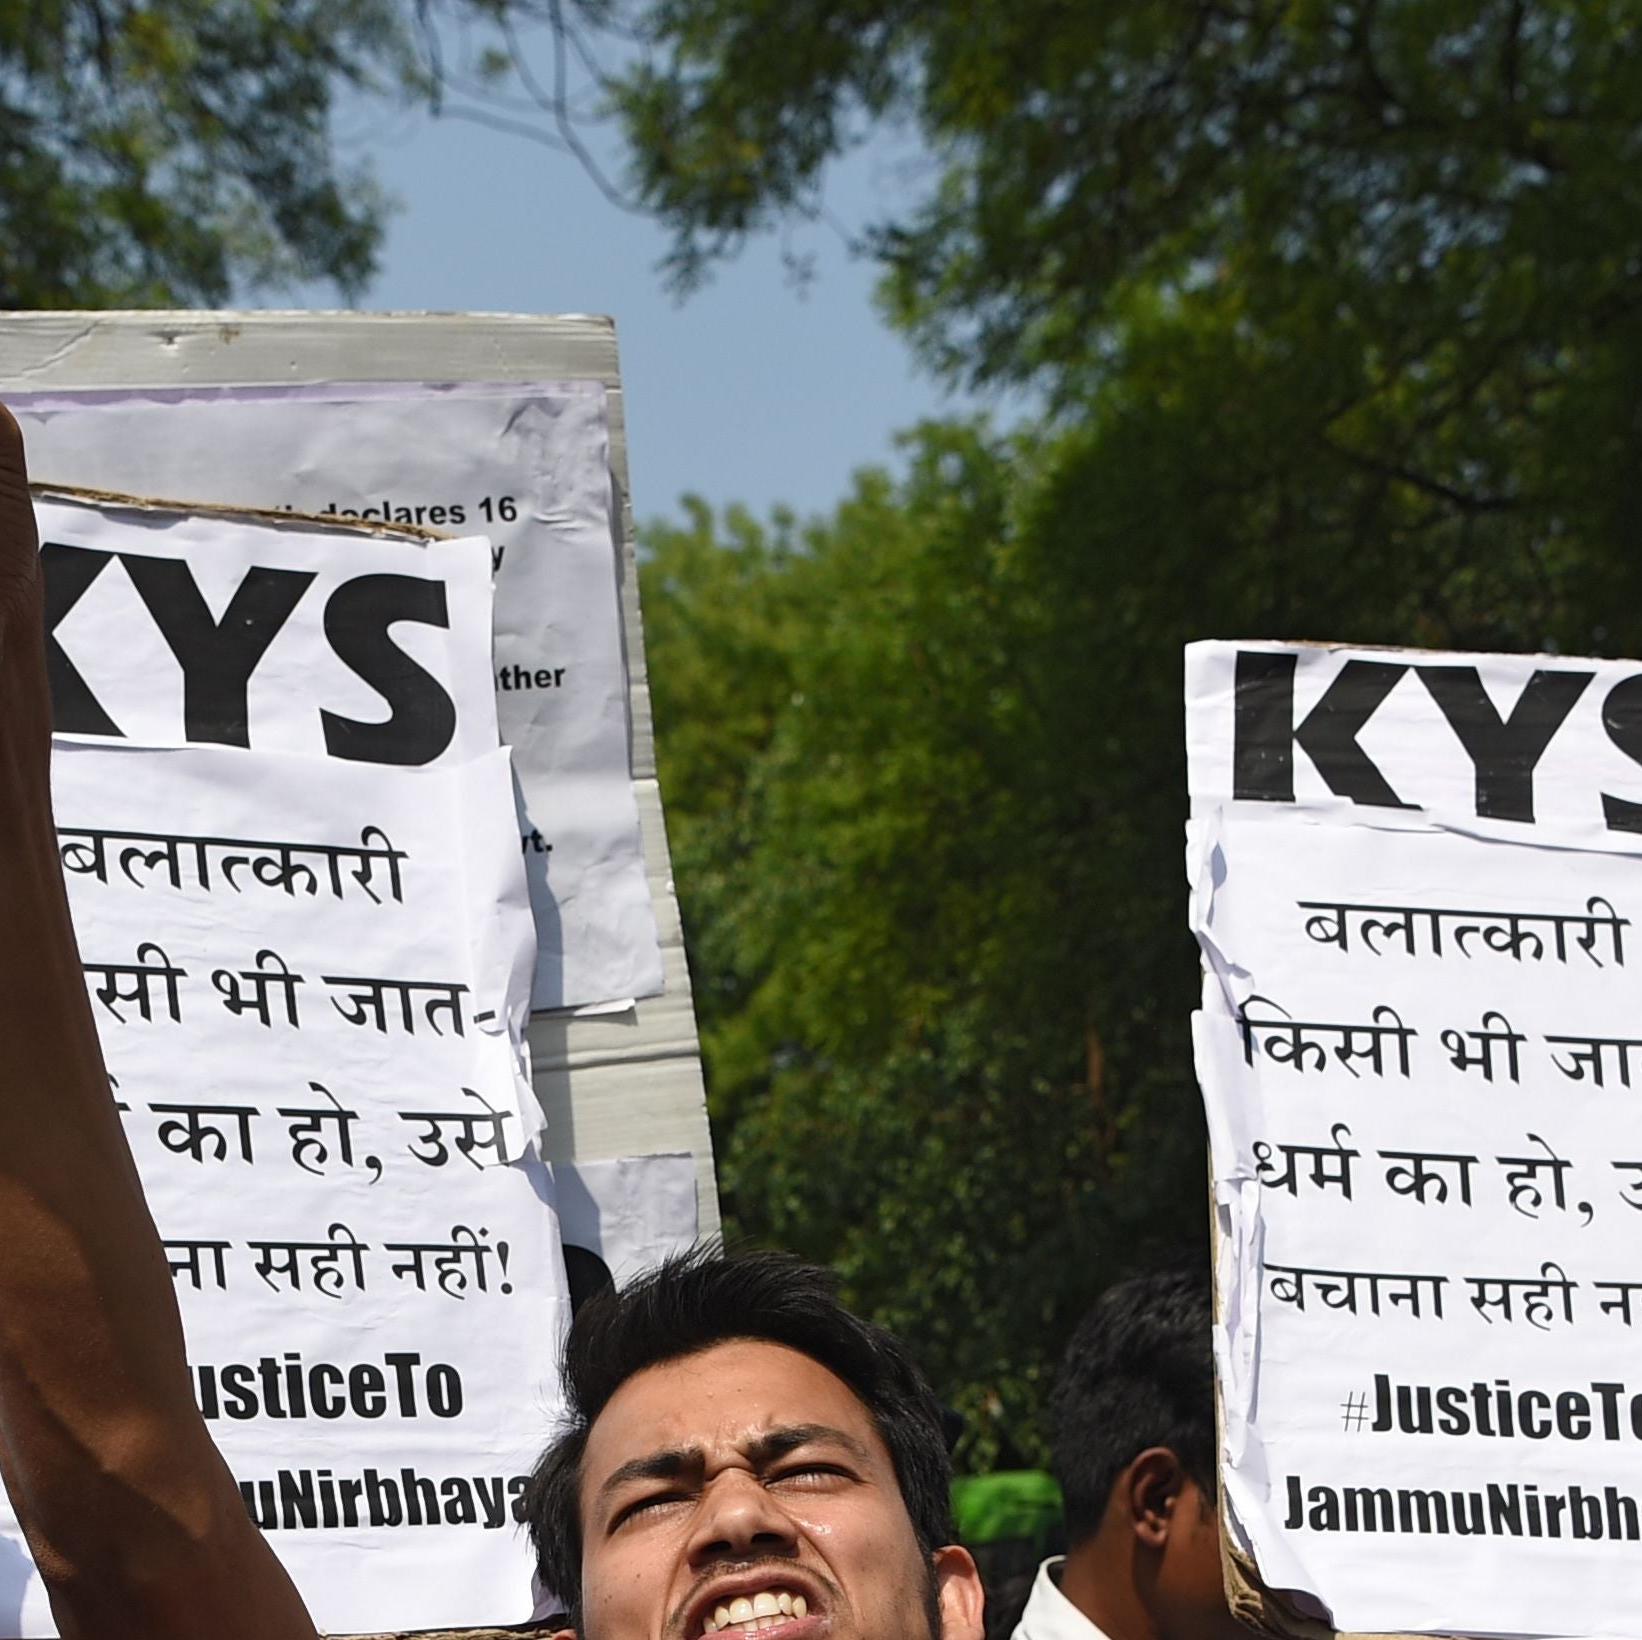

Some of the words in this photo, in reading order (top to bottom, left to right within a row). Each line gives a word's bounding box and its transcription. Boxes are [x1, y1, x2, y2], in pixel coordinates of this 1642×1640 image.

[478, 496, 518, 523] 16
[59, 826, 407, 905] बलात्कारी
[1297, 896, 1632, 967] बलात्कारी
[212, 949, 304, 1029] भी
[322, 975, 495, 1039] जात-
[1236, 994, 1417, 1078] किसी
[1440, 1010, 1525, 1083] भी
[148, 1103, 259, 1166] का
[277, 1081, 383, 1184] हो,
[398, 1087, 514, 1172] उसे
[1252, 1123, 1361, 1200] धर्म
[1377, 1150, 1479, 1207] का
[1496, 1133, 1594, 1227] हो,
[247, 1222, 368, 1300] सही
[383, 1226, 513, 1300] नहीं!
[1261, 1262, 1449, 1320] बचाना
[1465, 1262, 1577, 1331] सही
